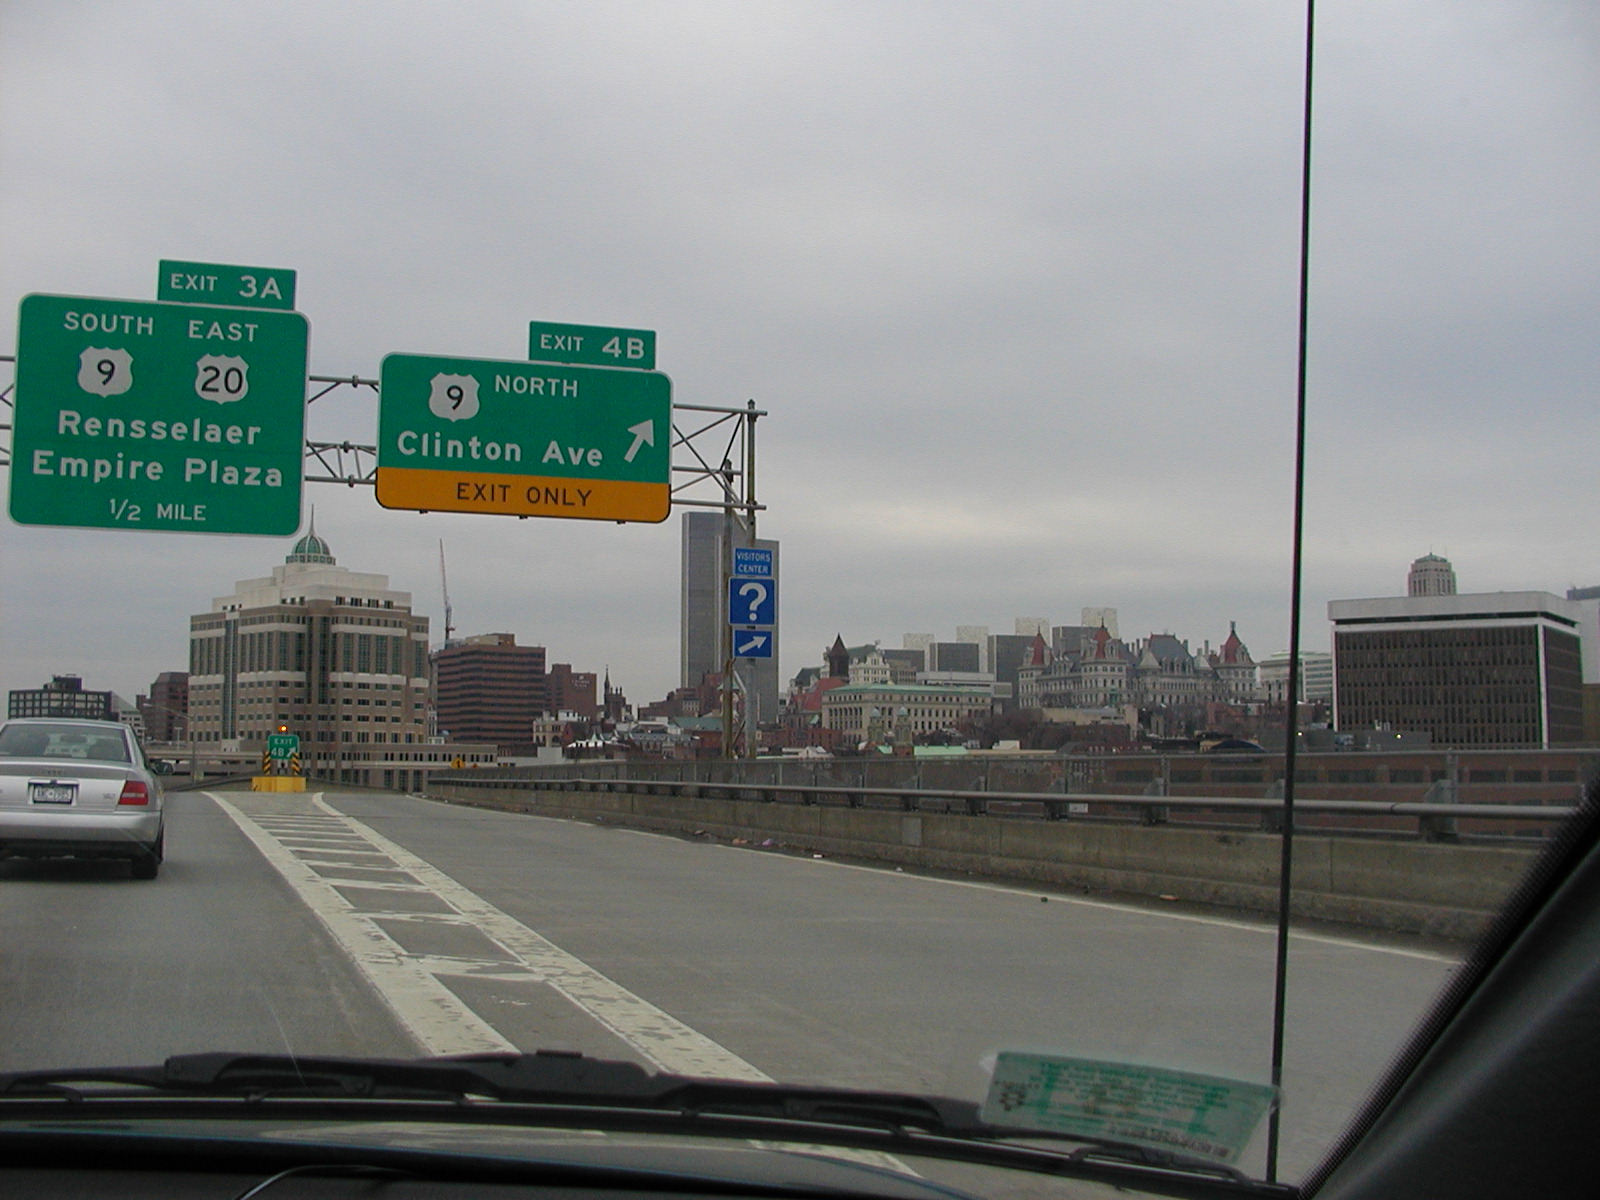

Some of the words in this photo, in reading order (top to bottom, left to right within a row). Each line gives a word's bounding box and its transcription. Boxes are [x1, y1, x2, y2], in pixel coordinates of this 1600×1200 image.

[170, 273, 218, 292] EXIT
[238, 275, 283, 300] 3A
[63, 311, 154, 336] SOUTH
[188, 320, 259, 342] EAST
[540, 334, 584, 352] EXIT
[602, 336, 645, 359] 4B
[97, 359, 116, 386] 9
[200, 366, 244, 394] 20
[446, 384, 464, 411] 9
[494, 374, 579, 398] NORTH
[57, 410, 262, 445] Rensselaer
[397, 430, 522, 463] Clinton
[542, 440, 604, 467] Ave
[32, 449, 164, 484] Empire
[184, 457, 283, 487] Plaza
[456, 482, 512, 503] EXIT
[526, 486, 593, 507] ONLY
[156, 503, 207, 521] MILE
[736, 552, 771, 562] VISITORS
[737, 564, 769, 574] CENTER
[271, 747, 285, 757] 4B
